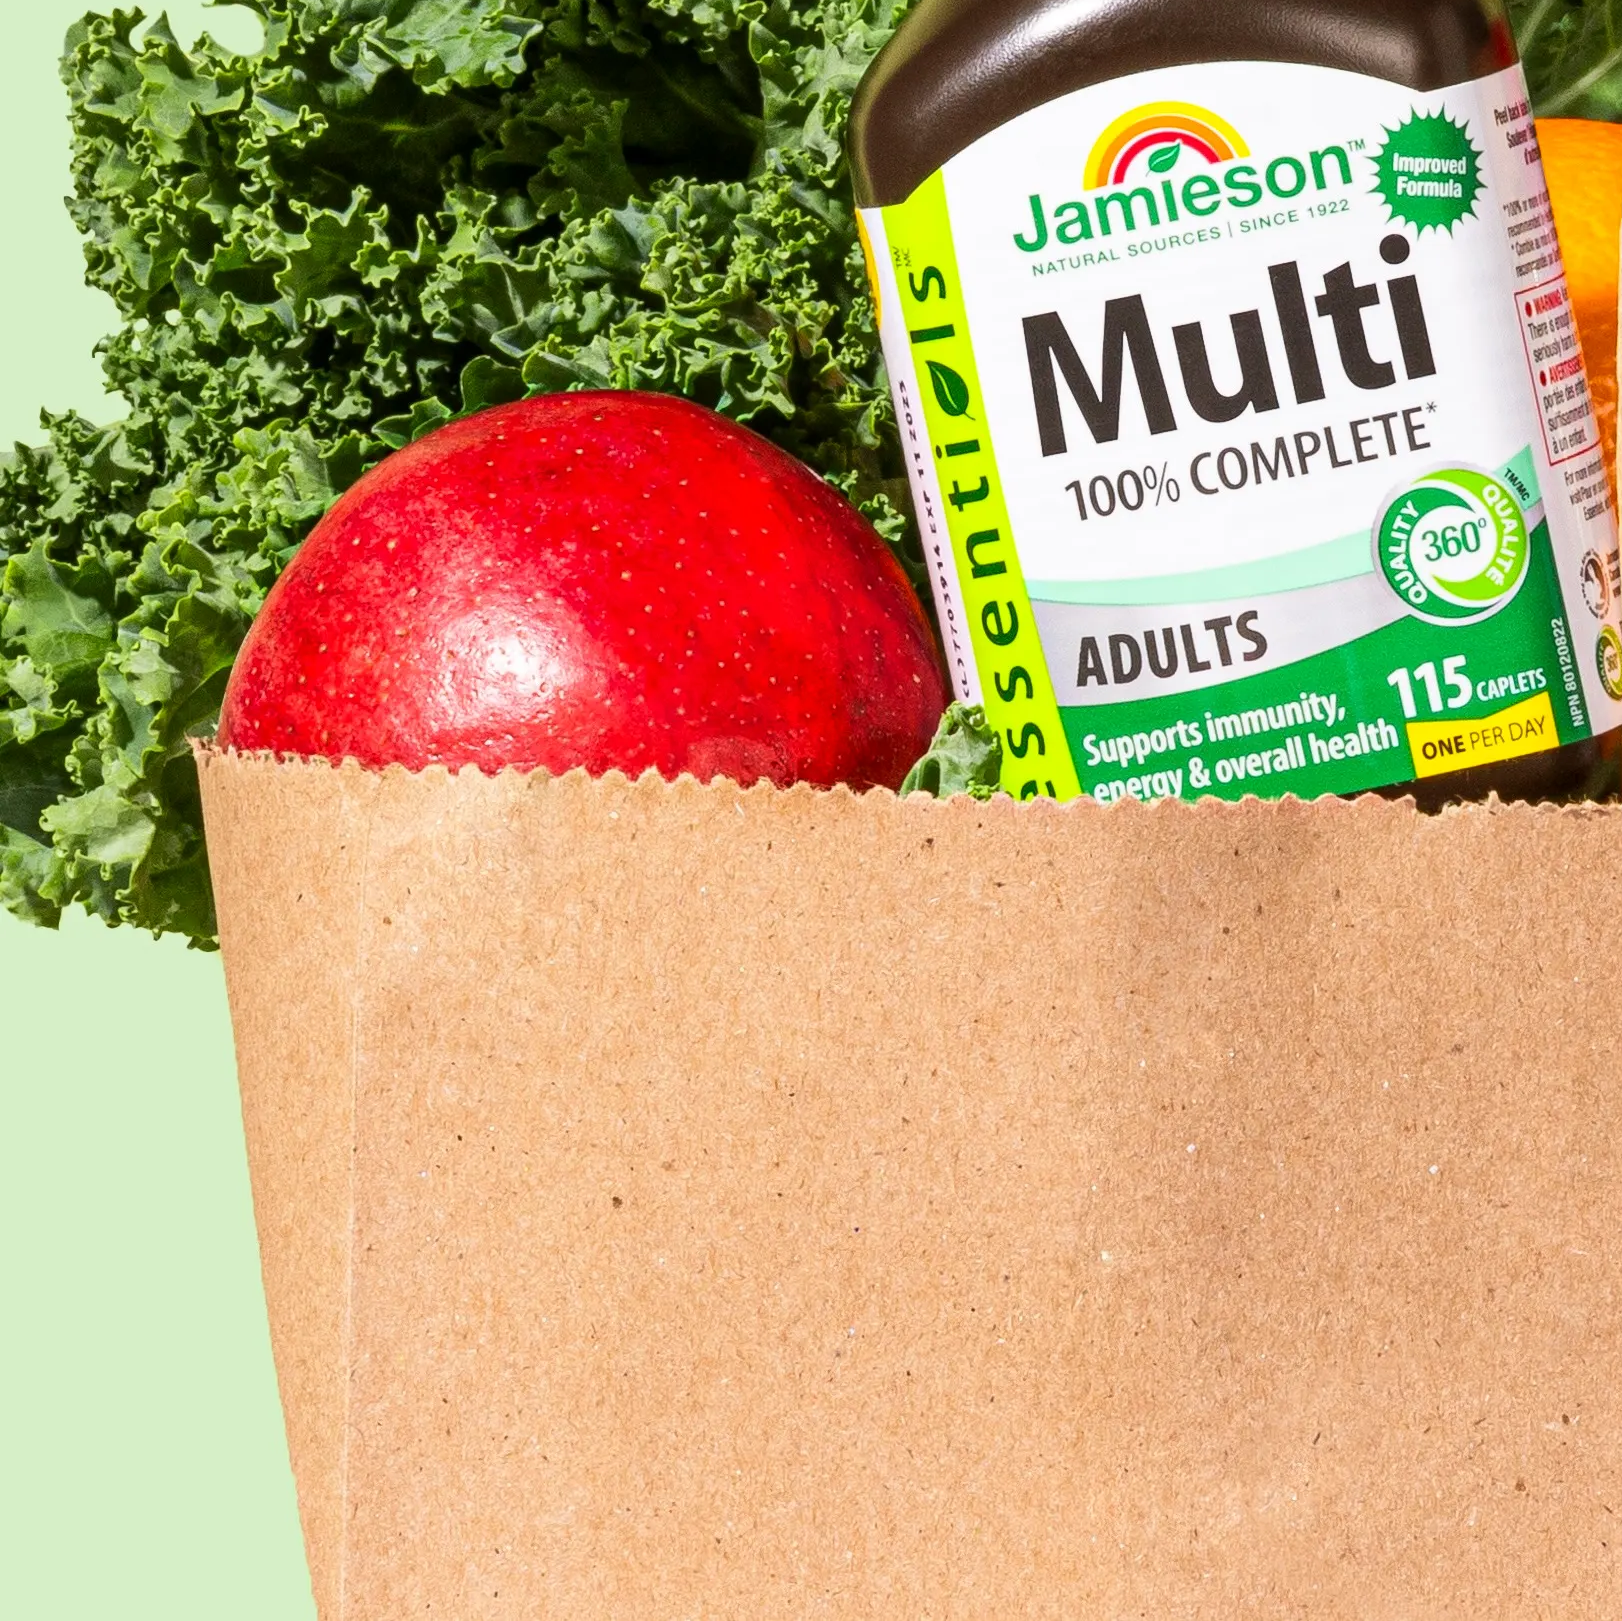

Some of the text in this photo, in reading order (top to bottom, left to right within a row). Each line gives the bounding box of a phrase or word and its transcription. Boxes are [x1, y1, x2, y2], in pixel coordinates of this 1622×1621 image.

[1013, 144, 1353, 253] Jamieson
[1392, 152, 1467, 177] Improved
[1396, 175, 1463, 198] Formula
[1032, 198, 1350, 277] NATURAL SOURCES SINCE 1922
[1021, 233, 1437, 457] Multi
[922, 491, 938, 535] EXP
[1064, 461, 1181, 521] 100%
[1504, 467, 1530, 502] TM/MC
[1388, 500, 1428, 605] QUALITY
[1076, 609, 1268, 687] ADULTS
[1550, 616, 1585, 728] NPN 80120822
[1387, 653, 1547, 719] 115 CAPLETS
[1082, 692, 1346, 768] Supports immunity,
[1187, 756, 1212, 789] &
[1214, 734, 1306, 783] overall
[1307, 717, 1400, 765] health
[1421, 715, 1546, 761] ONE PER DAY
